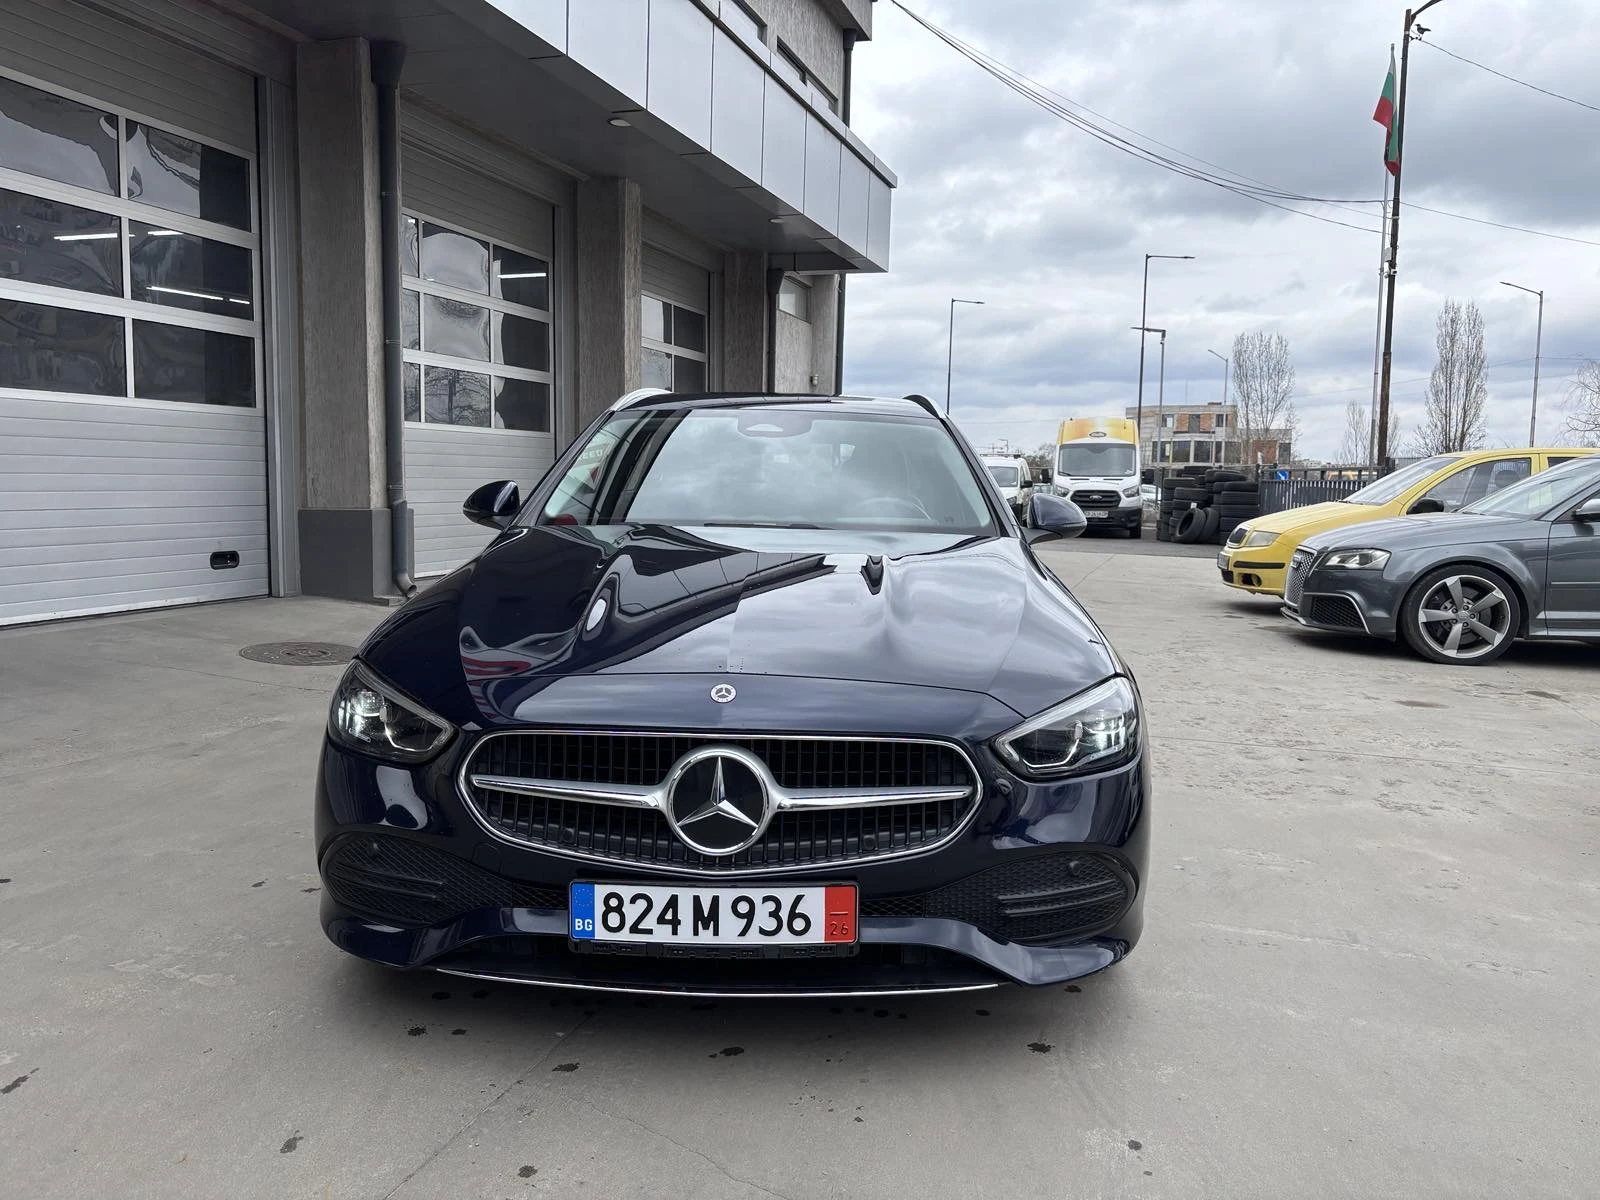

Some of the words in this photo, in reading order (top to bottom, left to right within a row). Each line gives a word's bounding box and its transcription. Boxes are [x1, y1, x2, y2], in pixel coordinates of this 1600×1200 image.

[602, 891, 681, 936] 824
[693, 894, 719, 937] M
[731, 894, 812, 937] 936
[574, 918, 593, 931] BG
[830, 921, 849, 936] 26
